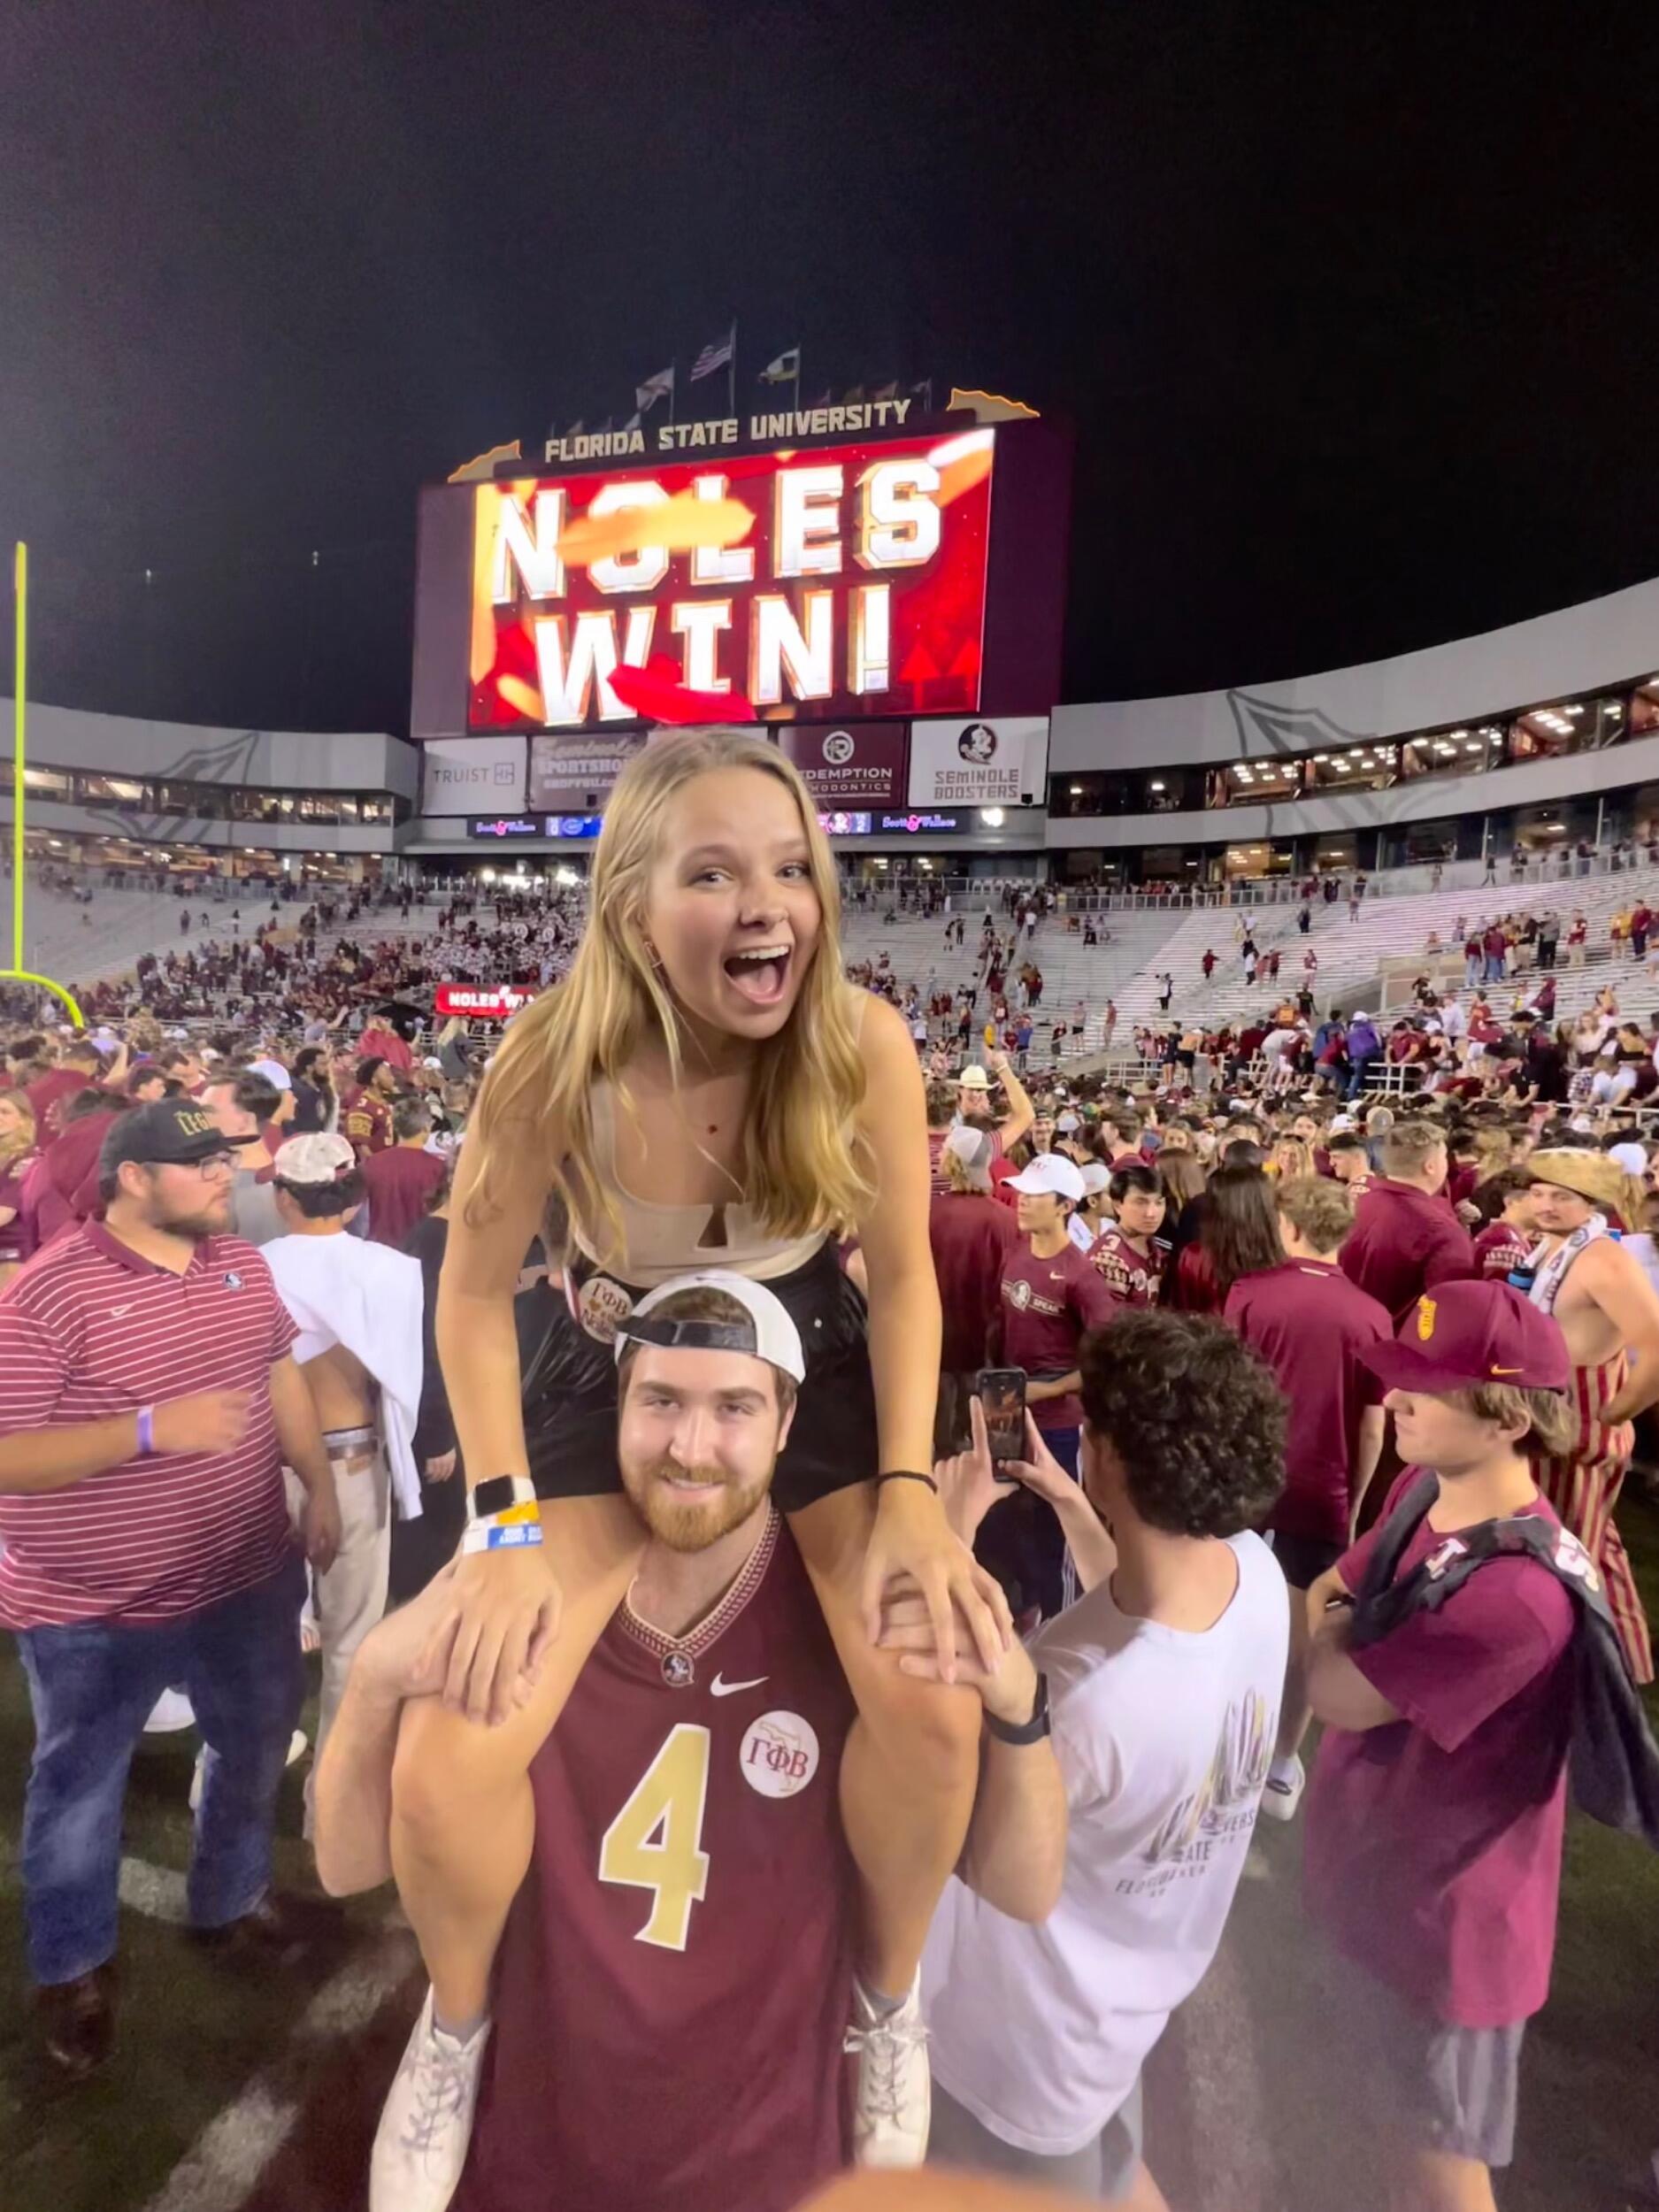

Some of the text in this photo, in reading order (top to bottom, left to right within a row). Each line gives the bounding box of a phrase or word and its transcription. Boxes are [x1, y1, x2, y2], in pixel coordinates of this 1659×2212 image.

[545, 399, 911, 463] FLORIDA STATE UNIVERSITY
[492, 458, 941, 604] NOLES
[534, 584, 890, 726] WIN!
[433, 768, 489, 784] TRUIST
[538, 758, 626, 774] SPORTSHO
[934, 768, 1019, 785] SEMINOLE
[933, 784, 1018, 801] BOOSTERS
[598, 1722, 710, 1952] 4
